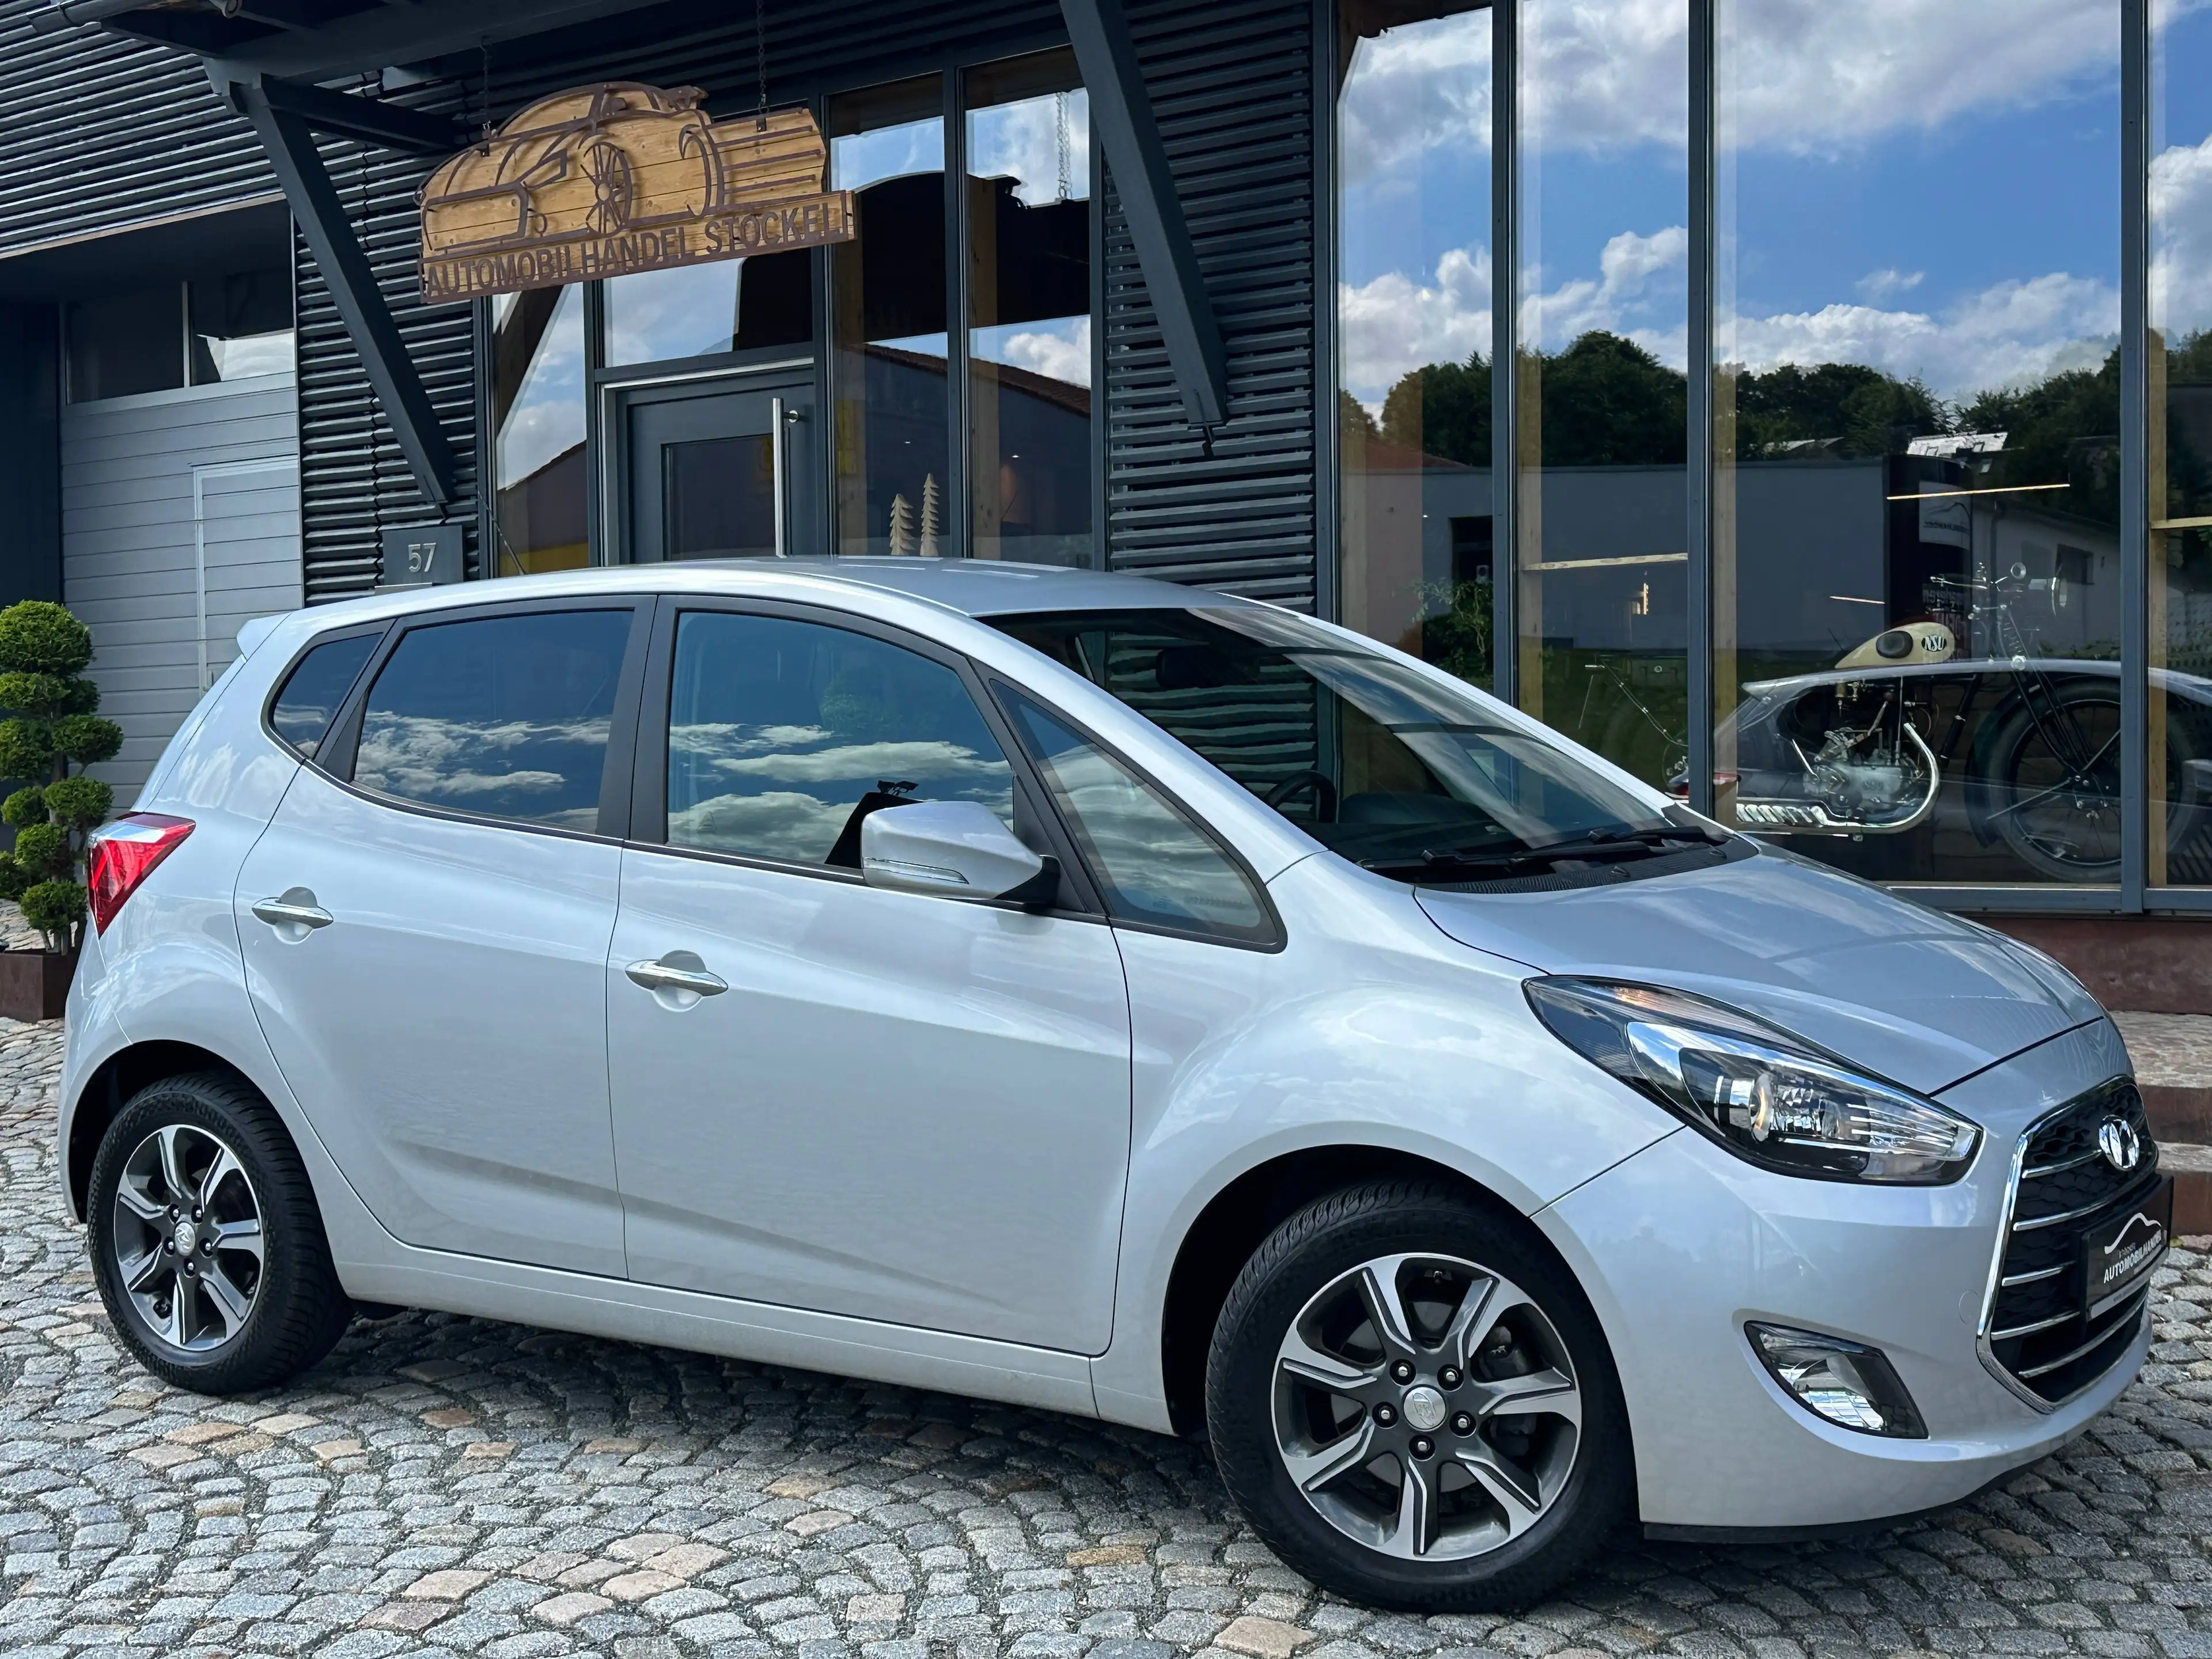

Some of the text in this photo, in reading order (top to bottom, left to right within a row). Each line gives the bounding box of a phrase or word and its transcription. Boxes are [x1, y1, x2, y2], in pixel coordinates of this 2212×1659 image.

[427, 226, 695, 298] AUTOMOBILHANDEL
[408, 542, 437, 573] 57
[1924, 635, 1945, 652] NSU
